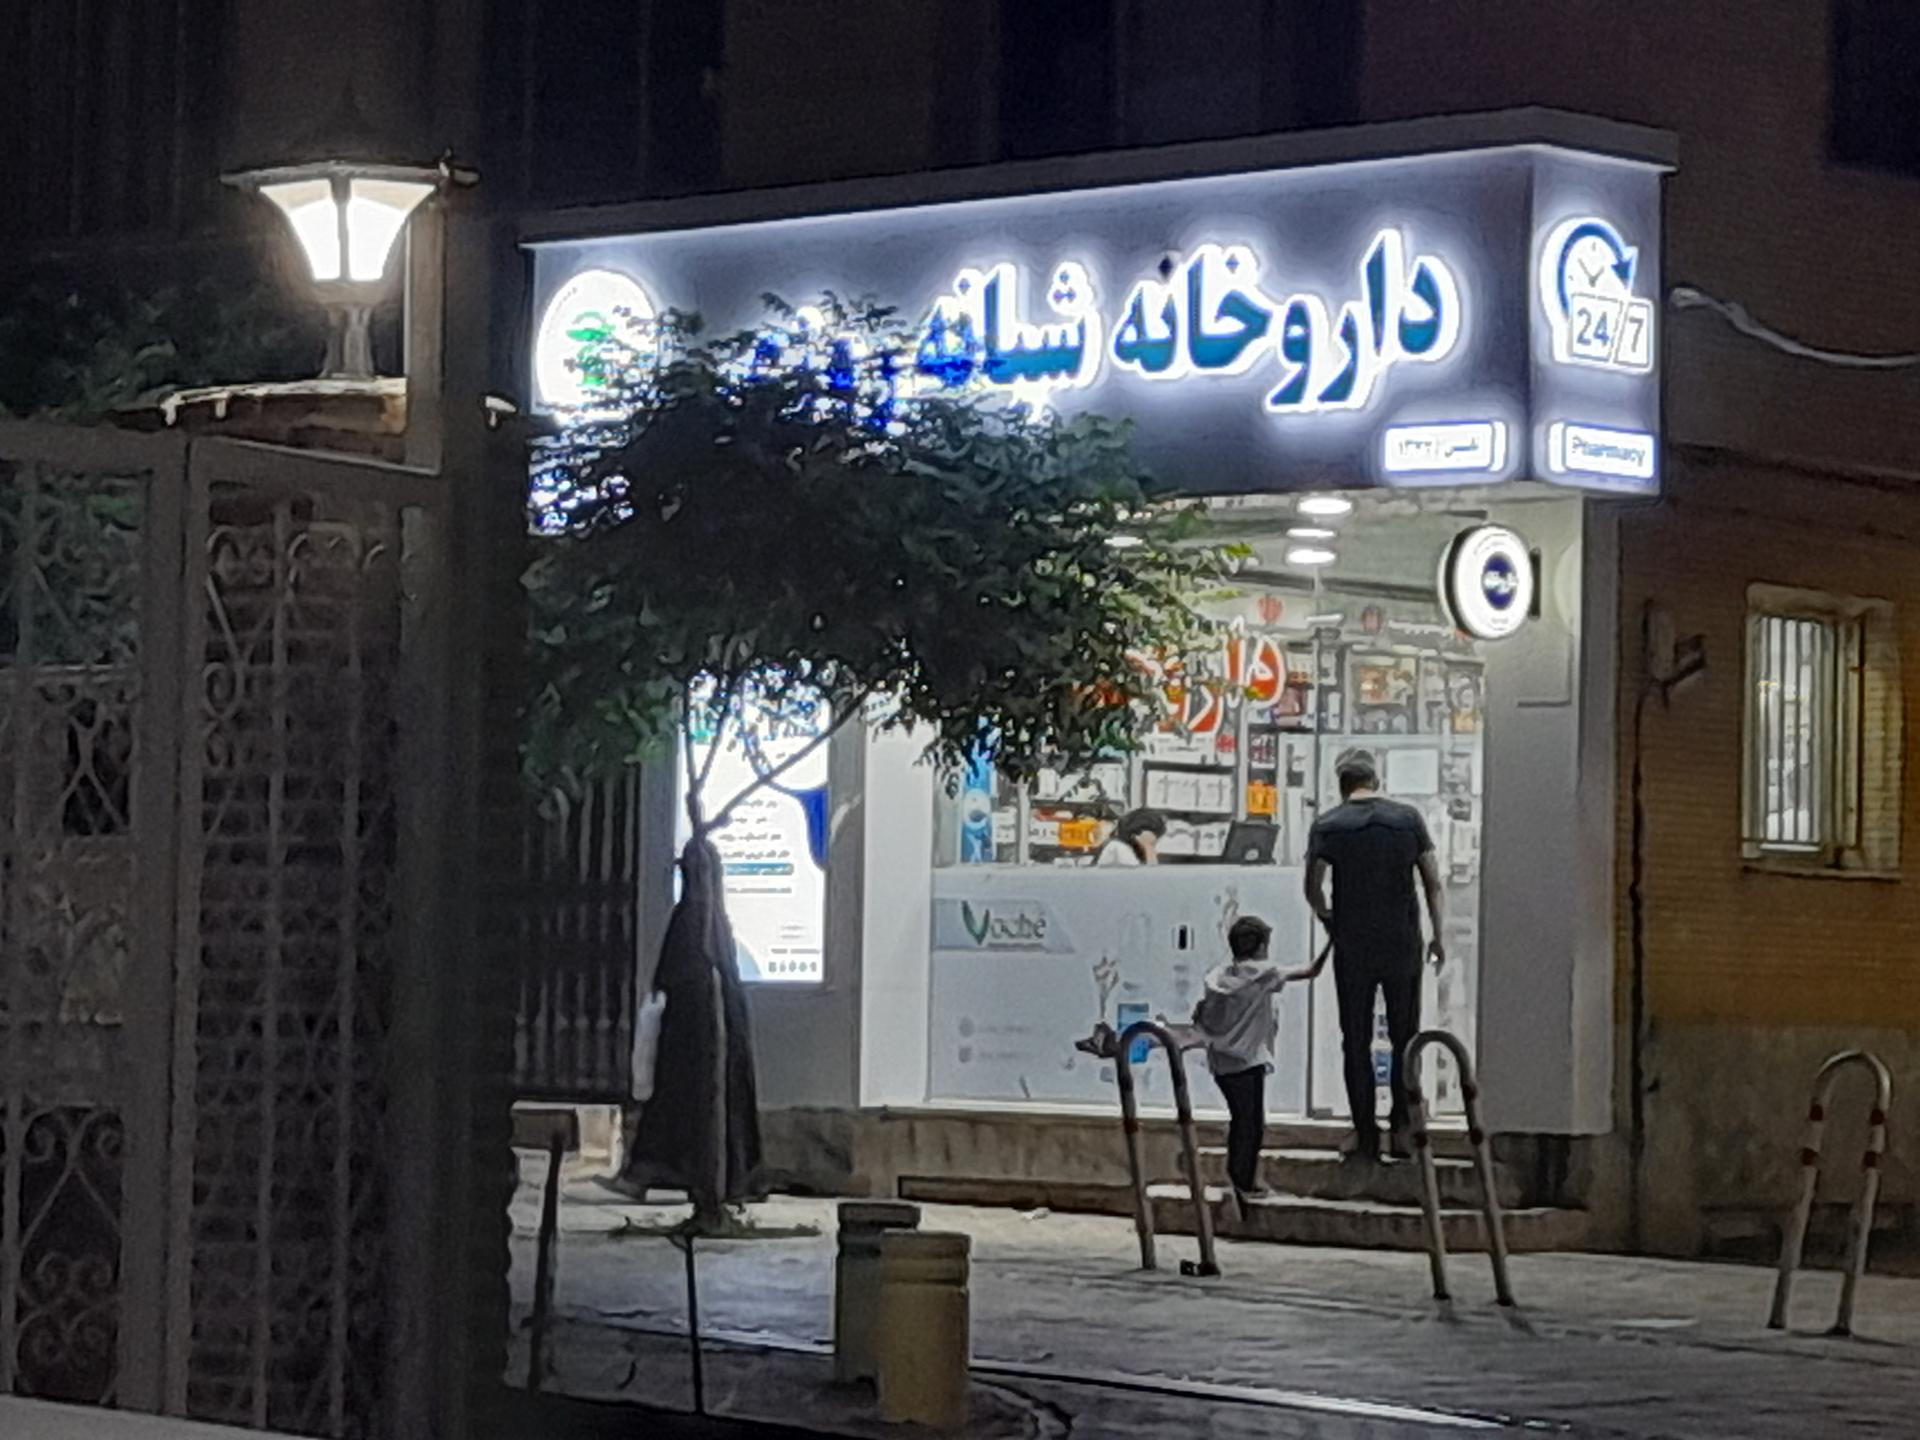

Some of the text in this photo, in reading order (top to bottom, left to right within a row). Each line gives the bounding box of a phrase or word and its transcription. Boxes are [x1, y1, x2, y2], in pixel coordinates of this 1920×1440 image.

[1113, 234, 1444, 406] داروخانه
[1576, 307, 1645, 353] 24 7
